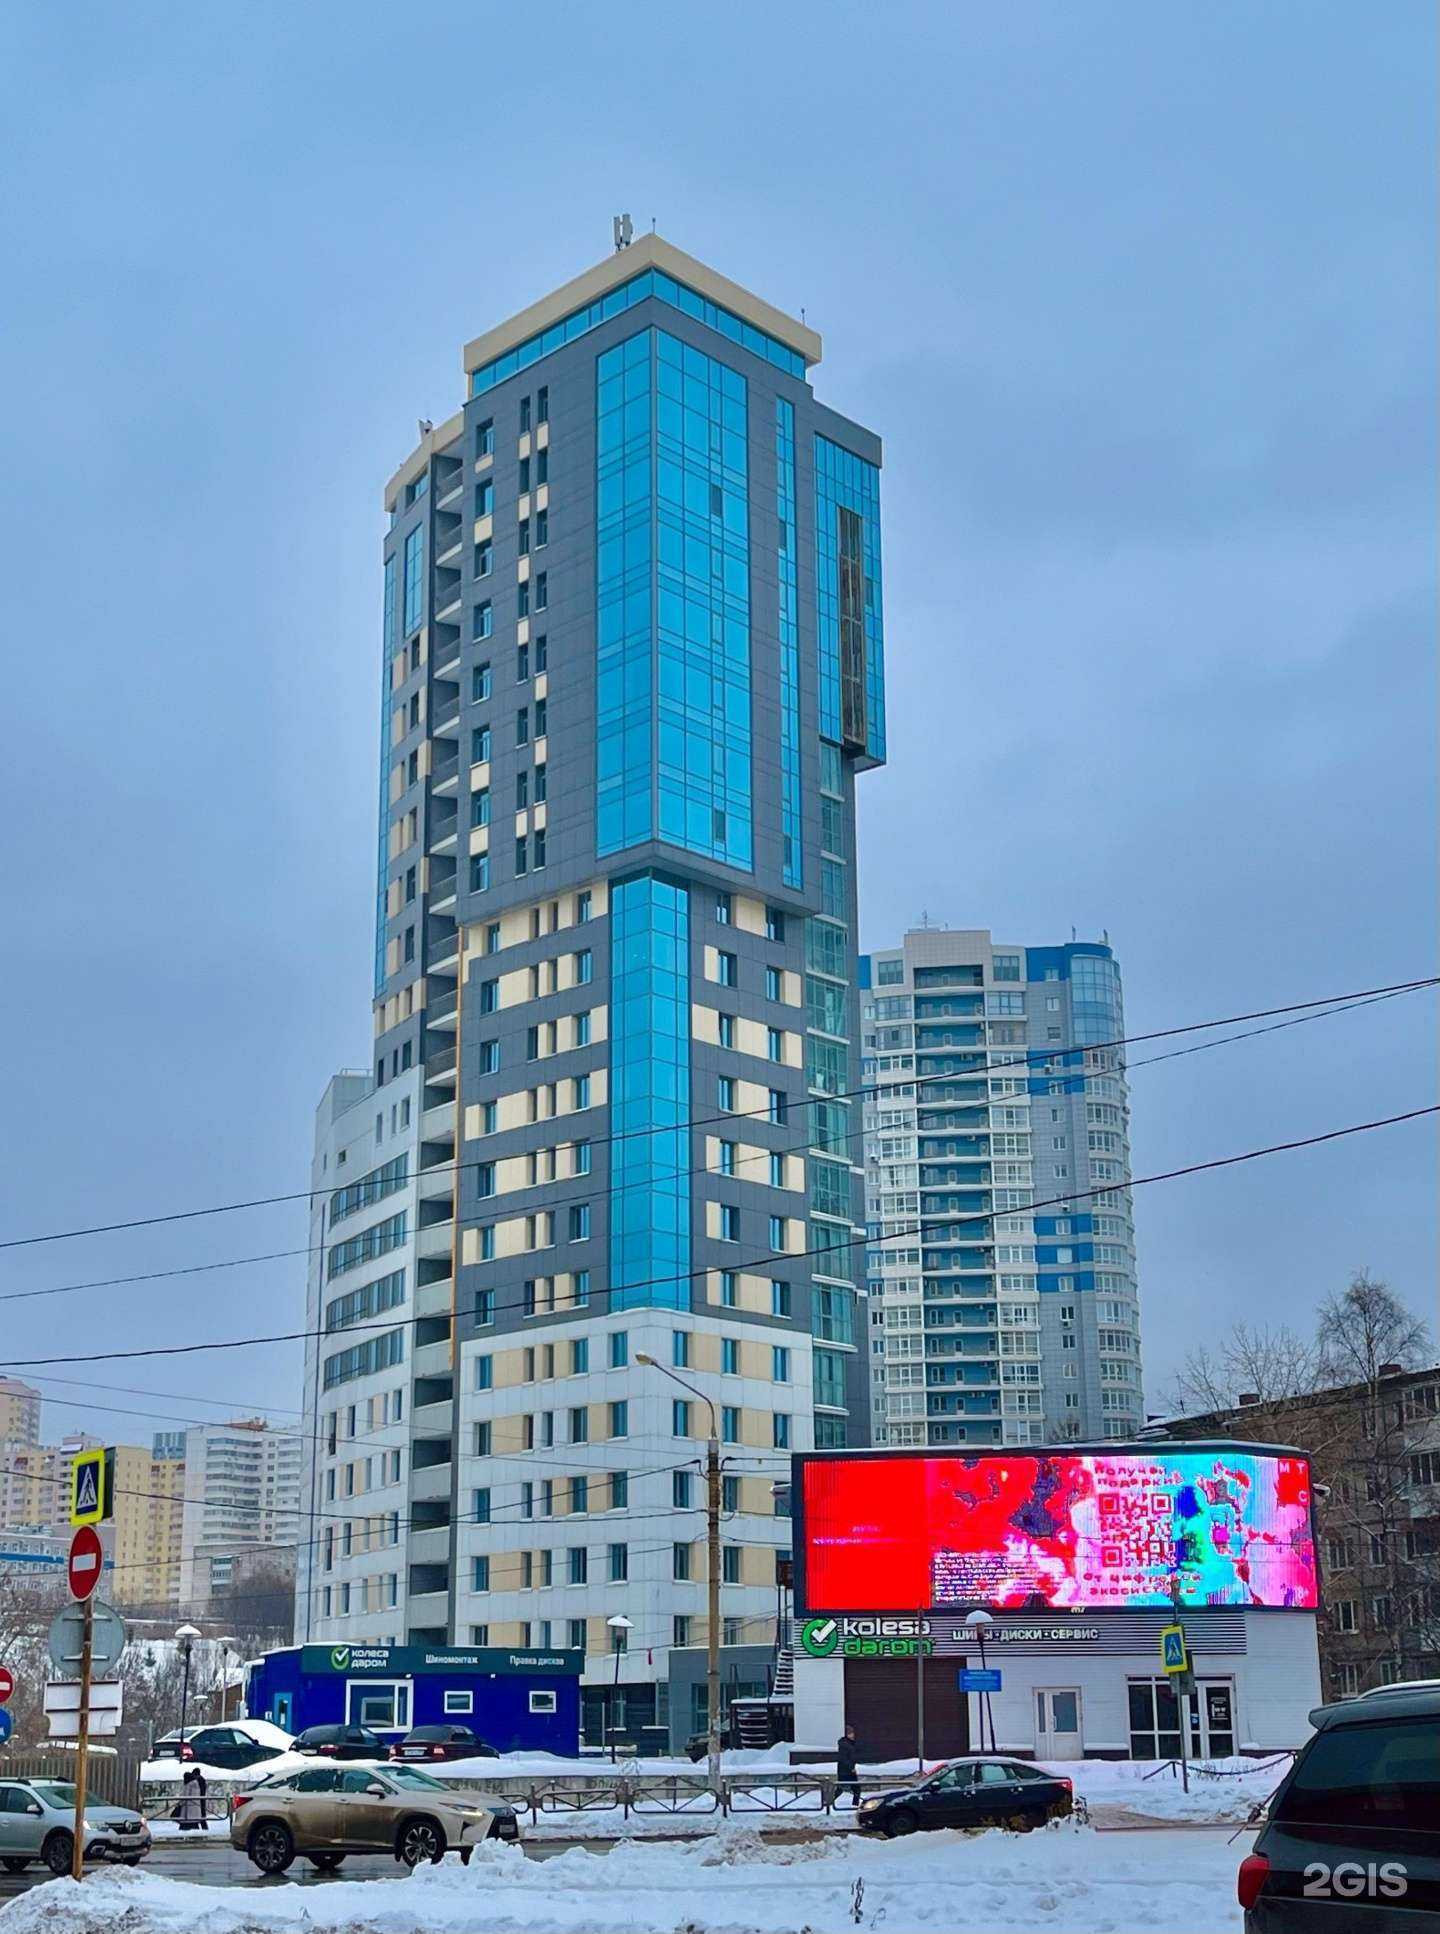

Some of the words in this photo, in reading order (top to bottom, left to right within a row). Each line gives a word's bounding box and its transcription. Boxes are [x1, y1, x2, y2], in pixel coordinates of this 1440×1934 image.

[843, 1617, 931, 1636] kolesa
[1000, 1629, 1043, 1642] ДИСКИ
[1051, 1628, 1099, 1640] СЕРВИС
[844, 1638, 932, 1655] darom
[351, 1650, 389, 1658] колеса
[425, 1654, 478, 1664] Шиномонтаж
[351, 1659, 387, 1669] даром
[509, 1655, 537, 1666] Правка
